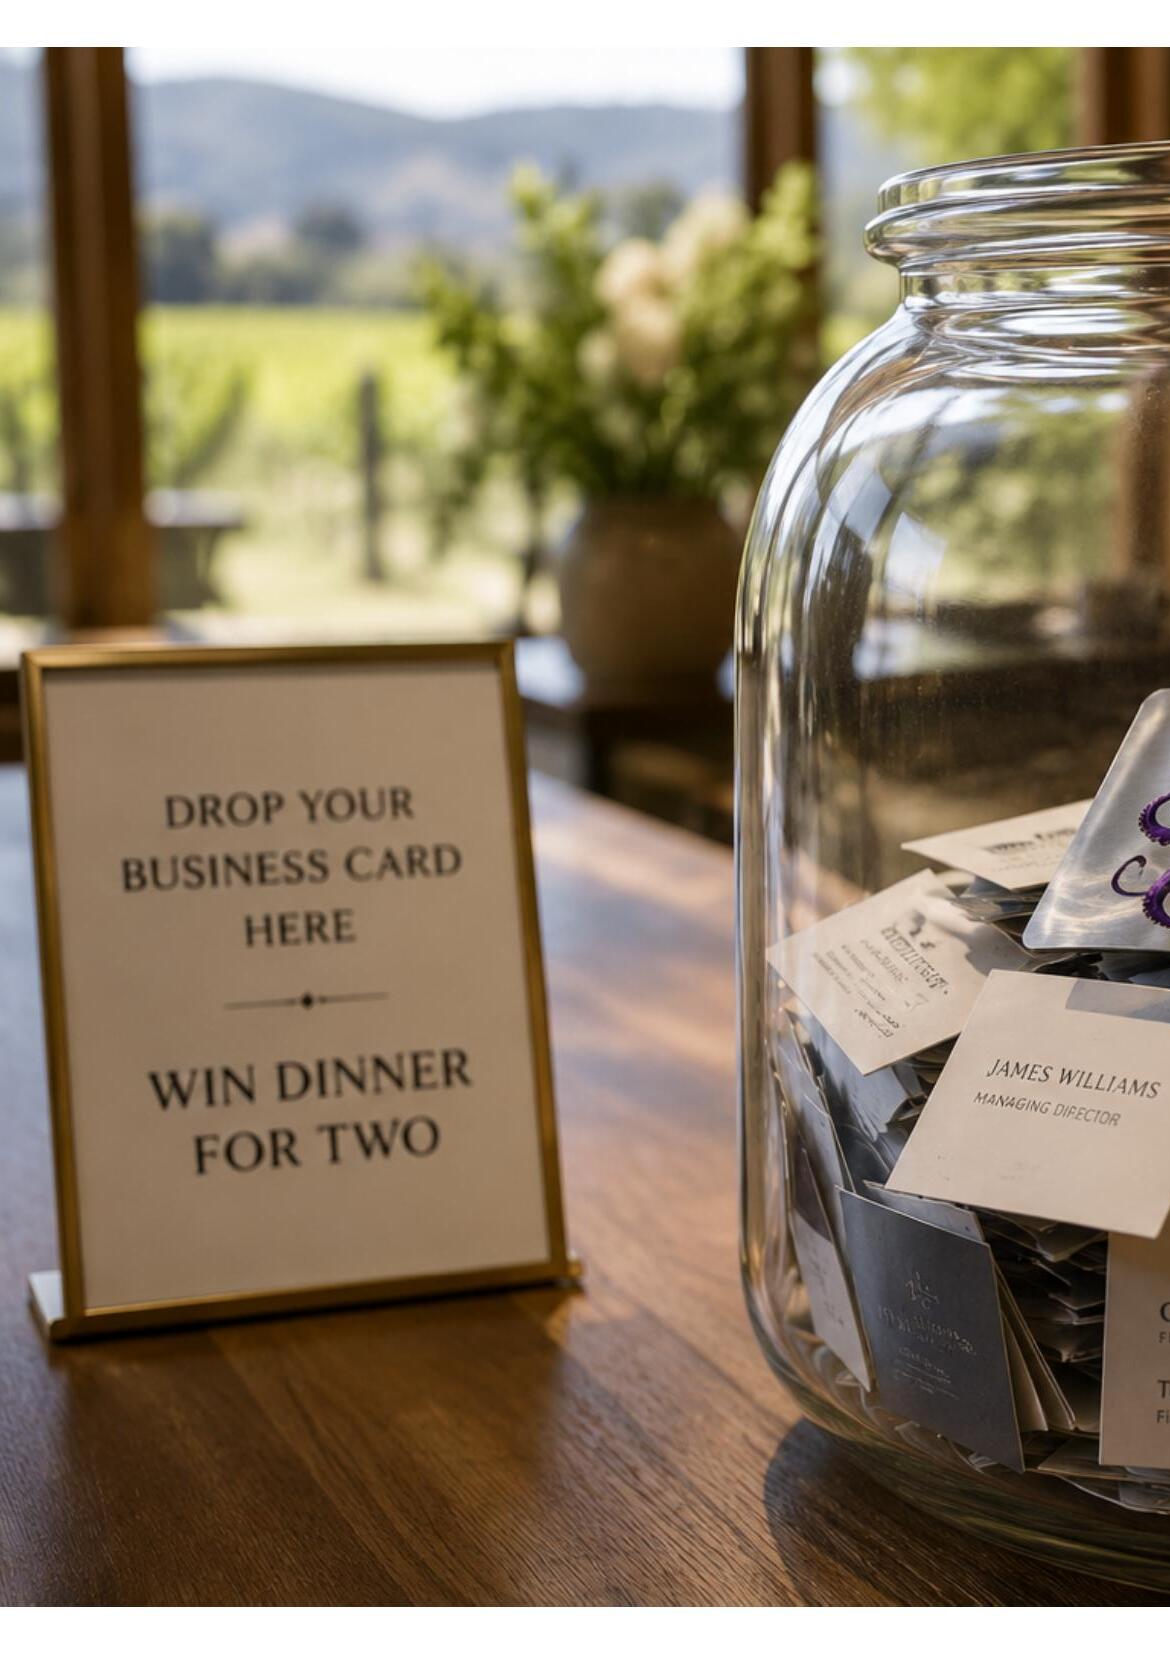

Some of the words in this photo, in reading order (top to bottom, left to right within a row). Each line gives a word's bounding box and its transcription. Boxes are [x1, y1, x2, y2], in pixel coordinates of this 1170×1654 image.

[165, 790, 286, 830] DROP
[298, 785, 416, 824] YOUR
[122, 849, 330, 893] BUSINESS
[343, 843, 463, 884] CARD
[244, 908, 357, 949] HERE
[147, 1064, 256, 1112] WIN
[275, 1048, 473, 1102] DINNER
[986, 1058, 1053, 1083] JAMES
[1058, 1067, 1162, 1099] WILLIAMS
[973, 1091, 1052, 1114] MANAGING
[193, 1127, 301, 1176] FOR
[315, 1114, 441, 1166] TWO
